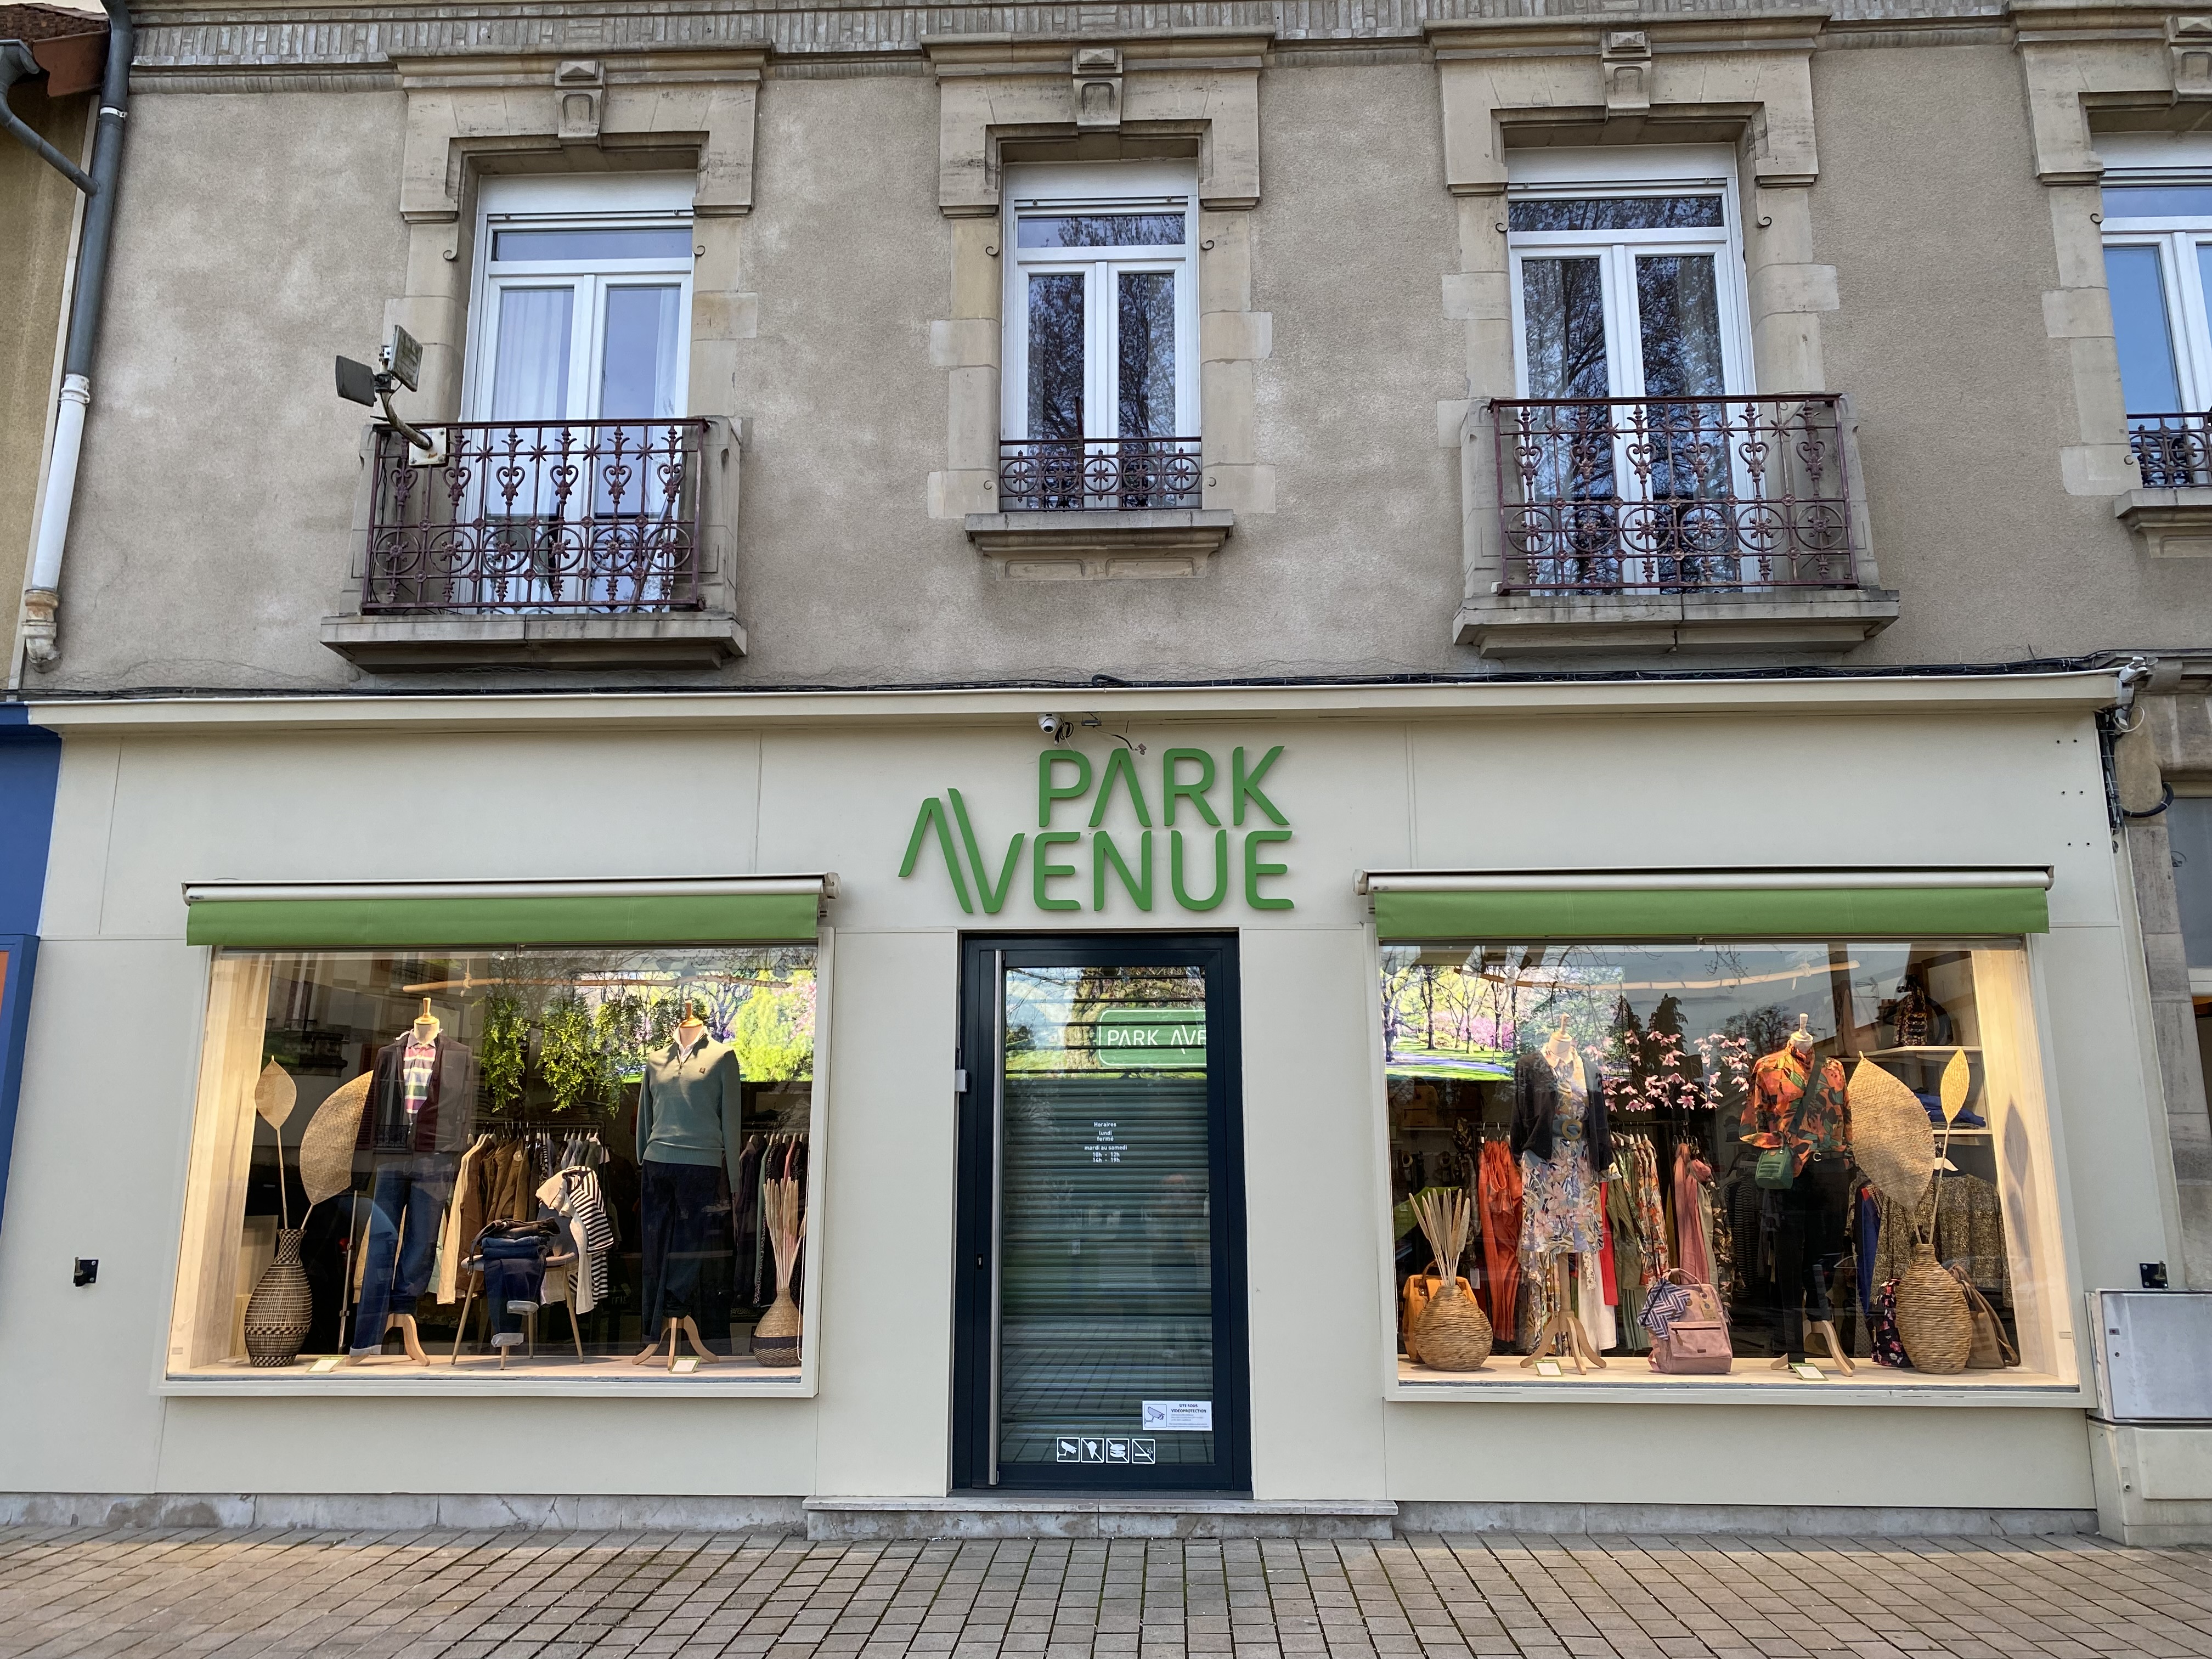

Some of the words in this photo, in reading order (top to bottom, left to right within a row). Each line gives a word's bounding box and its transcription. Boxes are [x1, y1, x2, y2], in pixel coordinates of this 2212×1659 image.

[1039, 746, 1290, 827] PARK
[898, 788, 1295, 913] AVENUE
[1107, 1029, 1159, 1046] PARK
